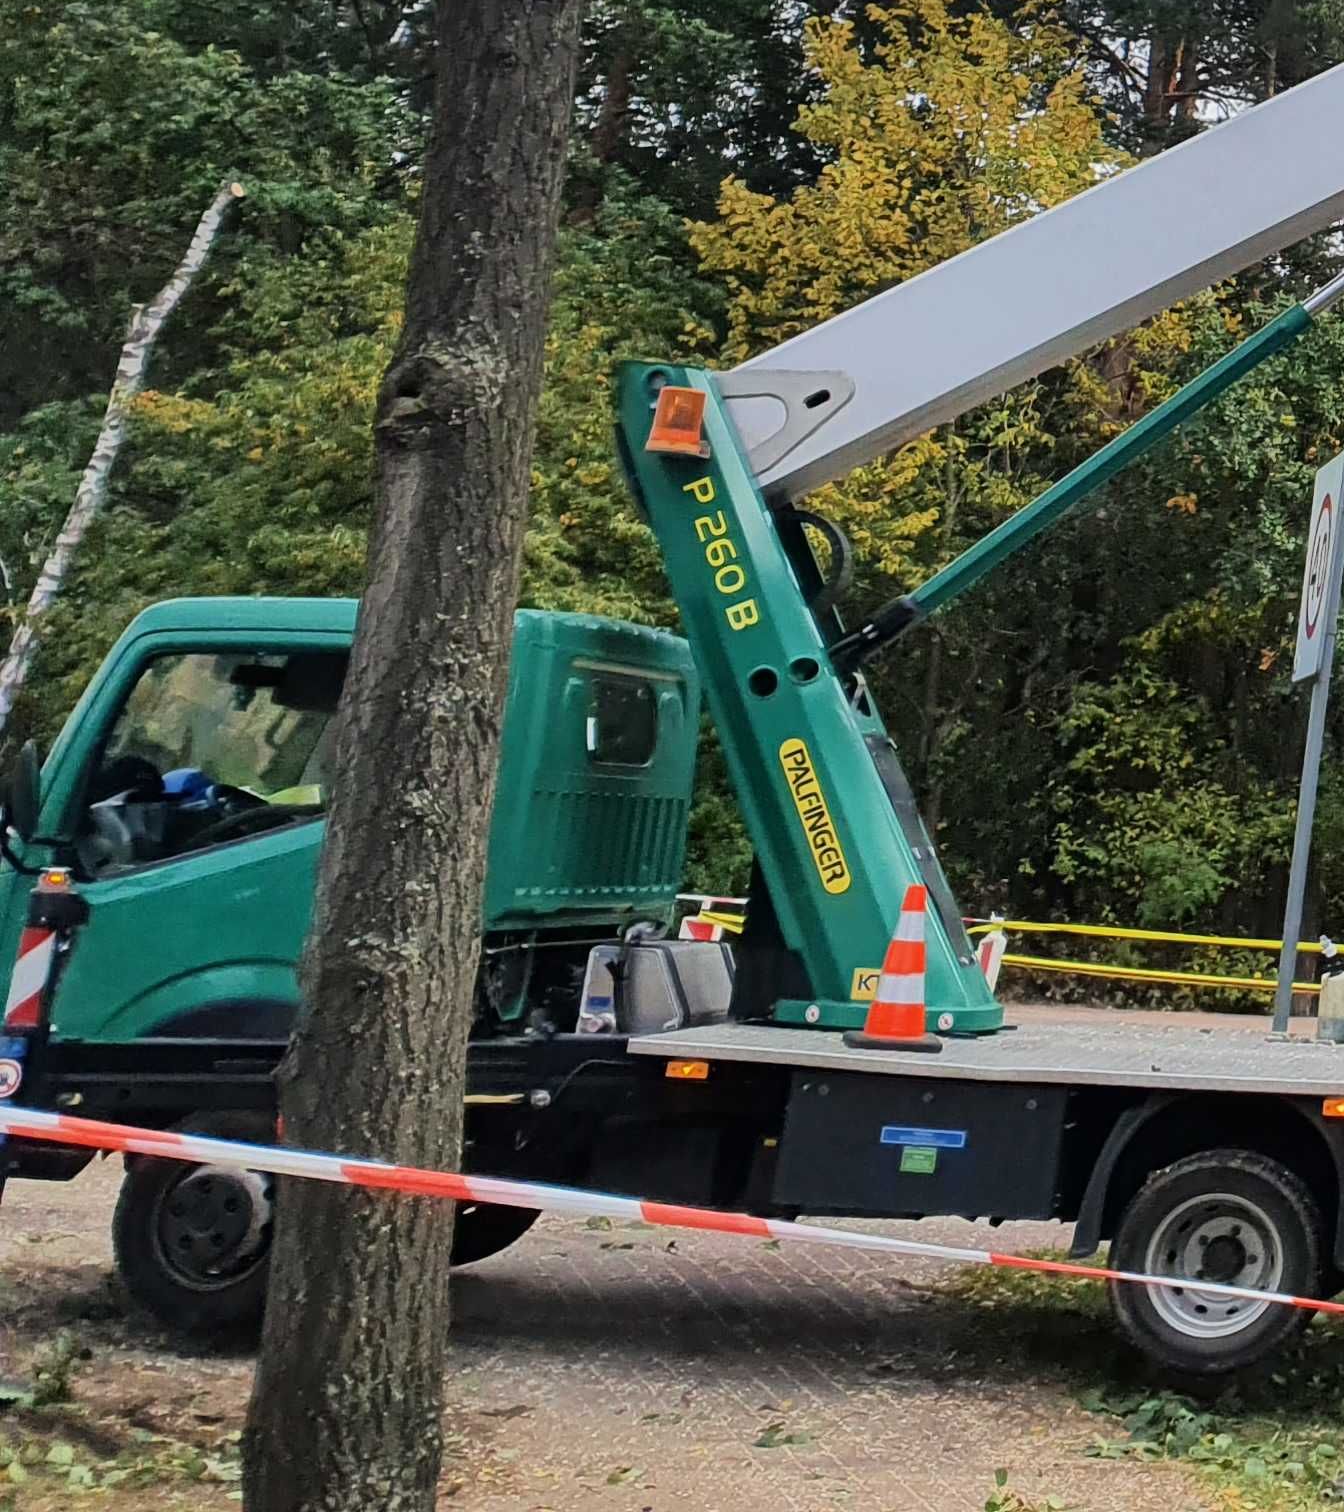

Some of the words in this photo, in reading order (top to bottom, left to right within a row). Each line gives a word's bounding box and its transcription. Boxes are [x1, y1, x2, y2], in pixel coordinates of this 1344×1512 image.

[683, 476, 716, 503] P
[695, 510, 745, 594] 260
[725, 599, 759, 631] B
[783, 748, 845, 884] PALFINGER
